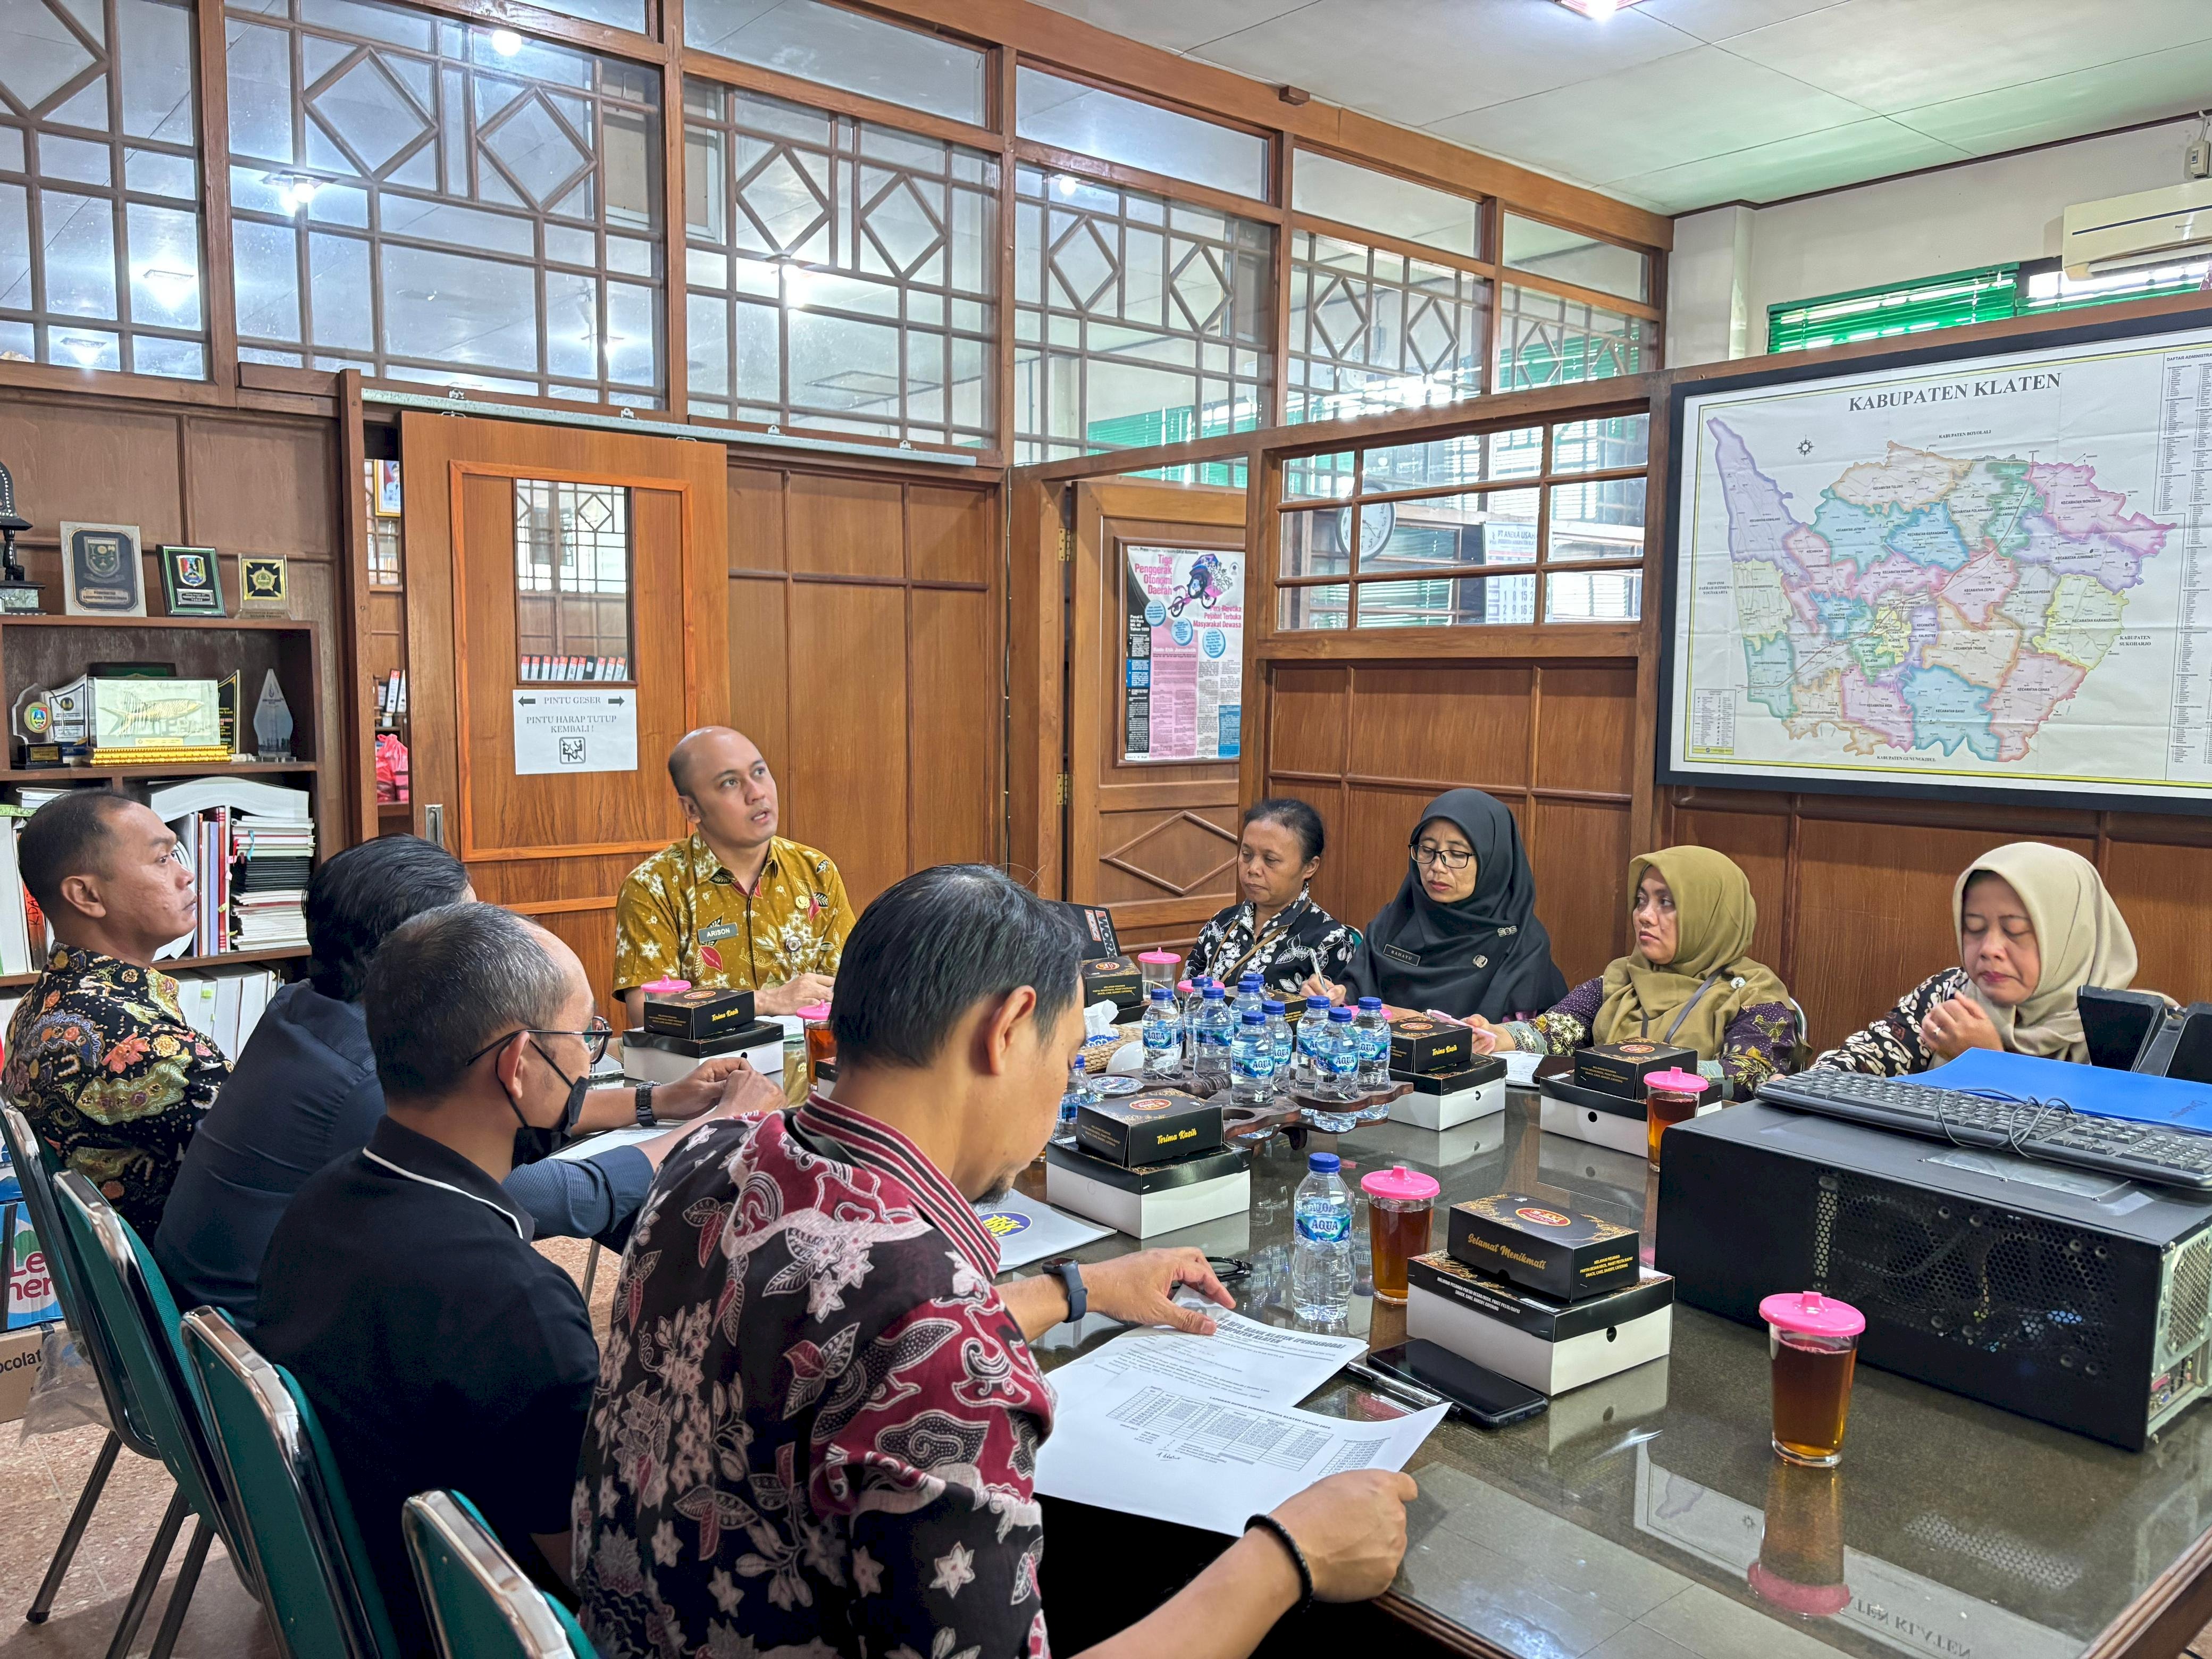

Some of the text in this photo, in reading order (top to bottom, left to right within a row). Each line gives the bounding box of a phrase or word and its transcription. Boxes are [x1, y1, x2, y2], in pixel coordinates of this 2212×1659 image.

[1849, 373, 2062, 411] KABUPATEN KLATEN
[1158, 554, 1172, 565] Tiga
[1135, 563, 1172, 577] Penggerak
[1521, 577, 1528, 588] 14
[1147, 585, 1172, 595] Daerah
[1521, 591, 1528, 601] 15
[1503, 605, 1527, 615] 2 9 16
[1193, 620, 1222, 629] Masyarakat
[706, 927, 731, 938] ARISON
[1098, 916, 1118, 957] WORX
[1391, 950, 1412, 960] RAHAYU
[711, 1012, 726, 1021] Terima
[1252, 1060, 1271, 1068] AQUA
[1336, 1057, 1354, 1065] AQUA
[1157, 1128, 1197, 1144] Terima Kasih
[1311, 1219, 1338, 1231] AQUA
[1468, 1233, 1547, 1270] Selamat Menikmati
[12, 1247, 46, 1277] Le
[1254, 1334, 1283, 1344] KLATEN
[1267, 1331, 1293, 1342] KLATEN
